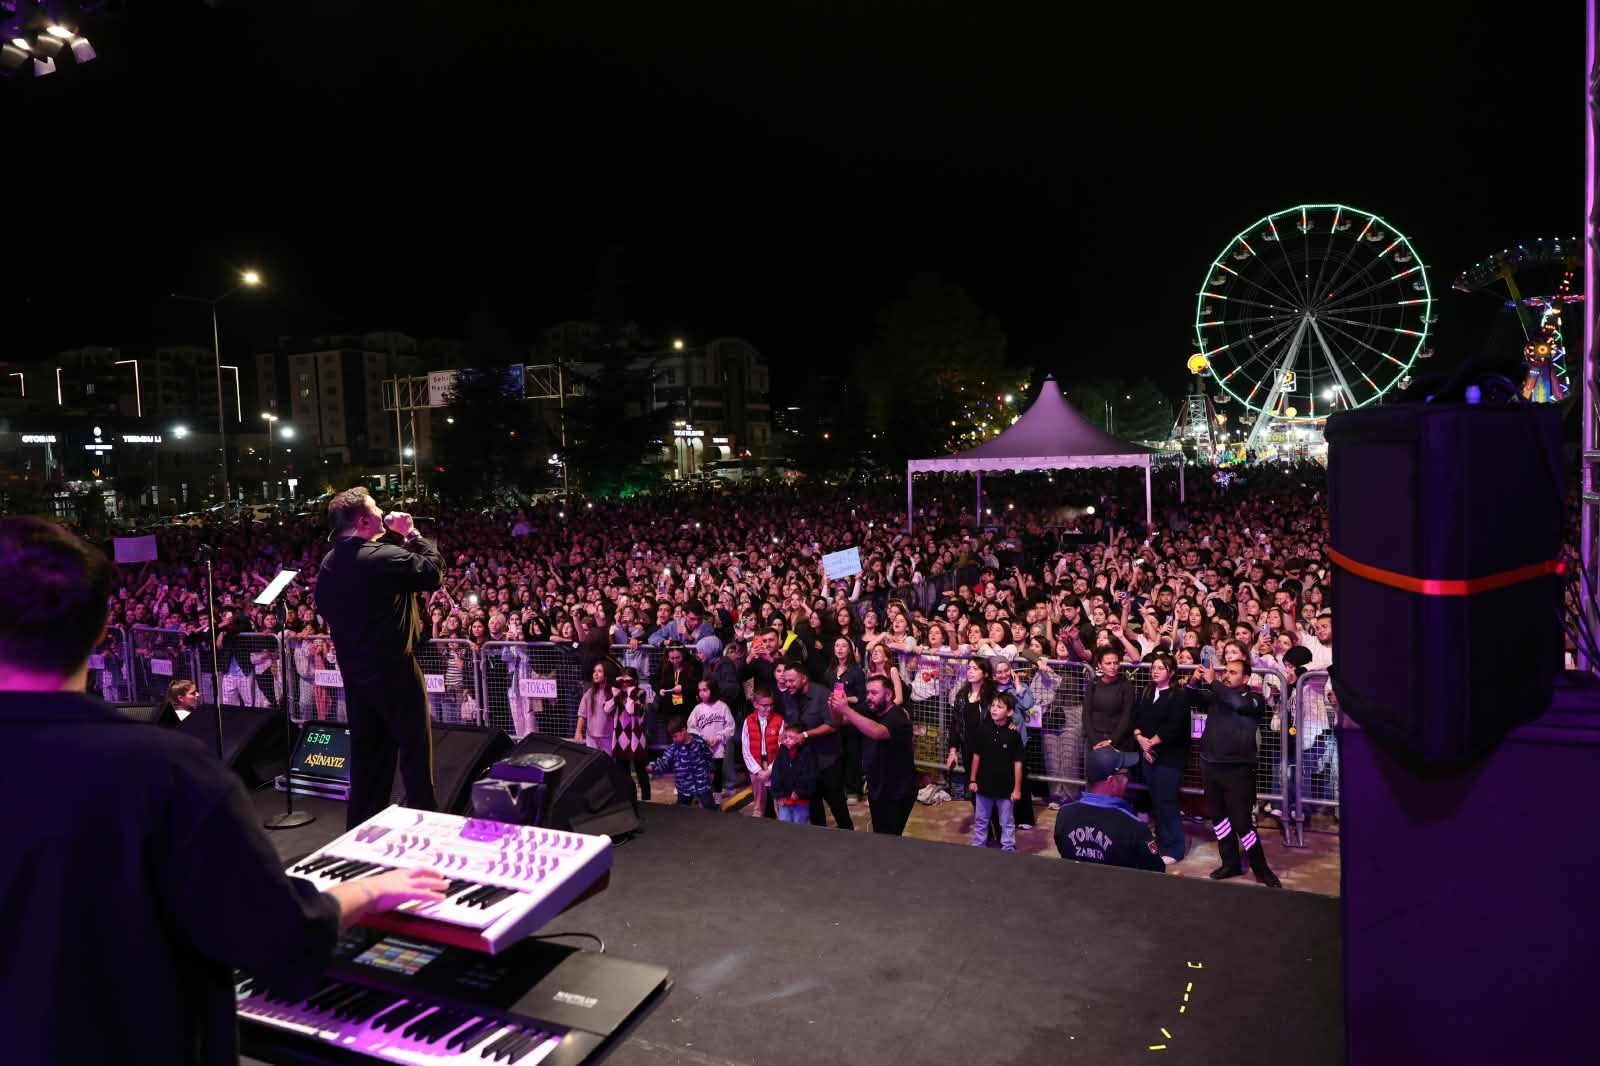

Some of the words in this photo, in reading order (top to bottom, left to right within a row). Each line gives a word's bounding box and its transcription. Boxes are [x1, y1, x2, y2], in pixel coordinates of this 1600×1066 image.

[527, 681, 550, 694] TOKAT
[307, 732, 331, 745] 63:09
[1067, 826, 1113, 851] TOKAT
